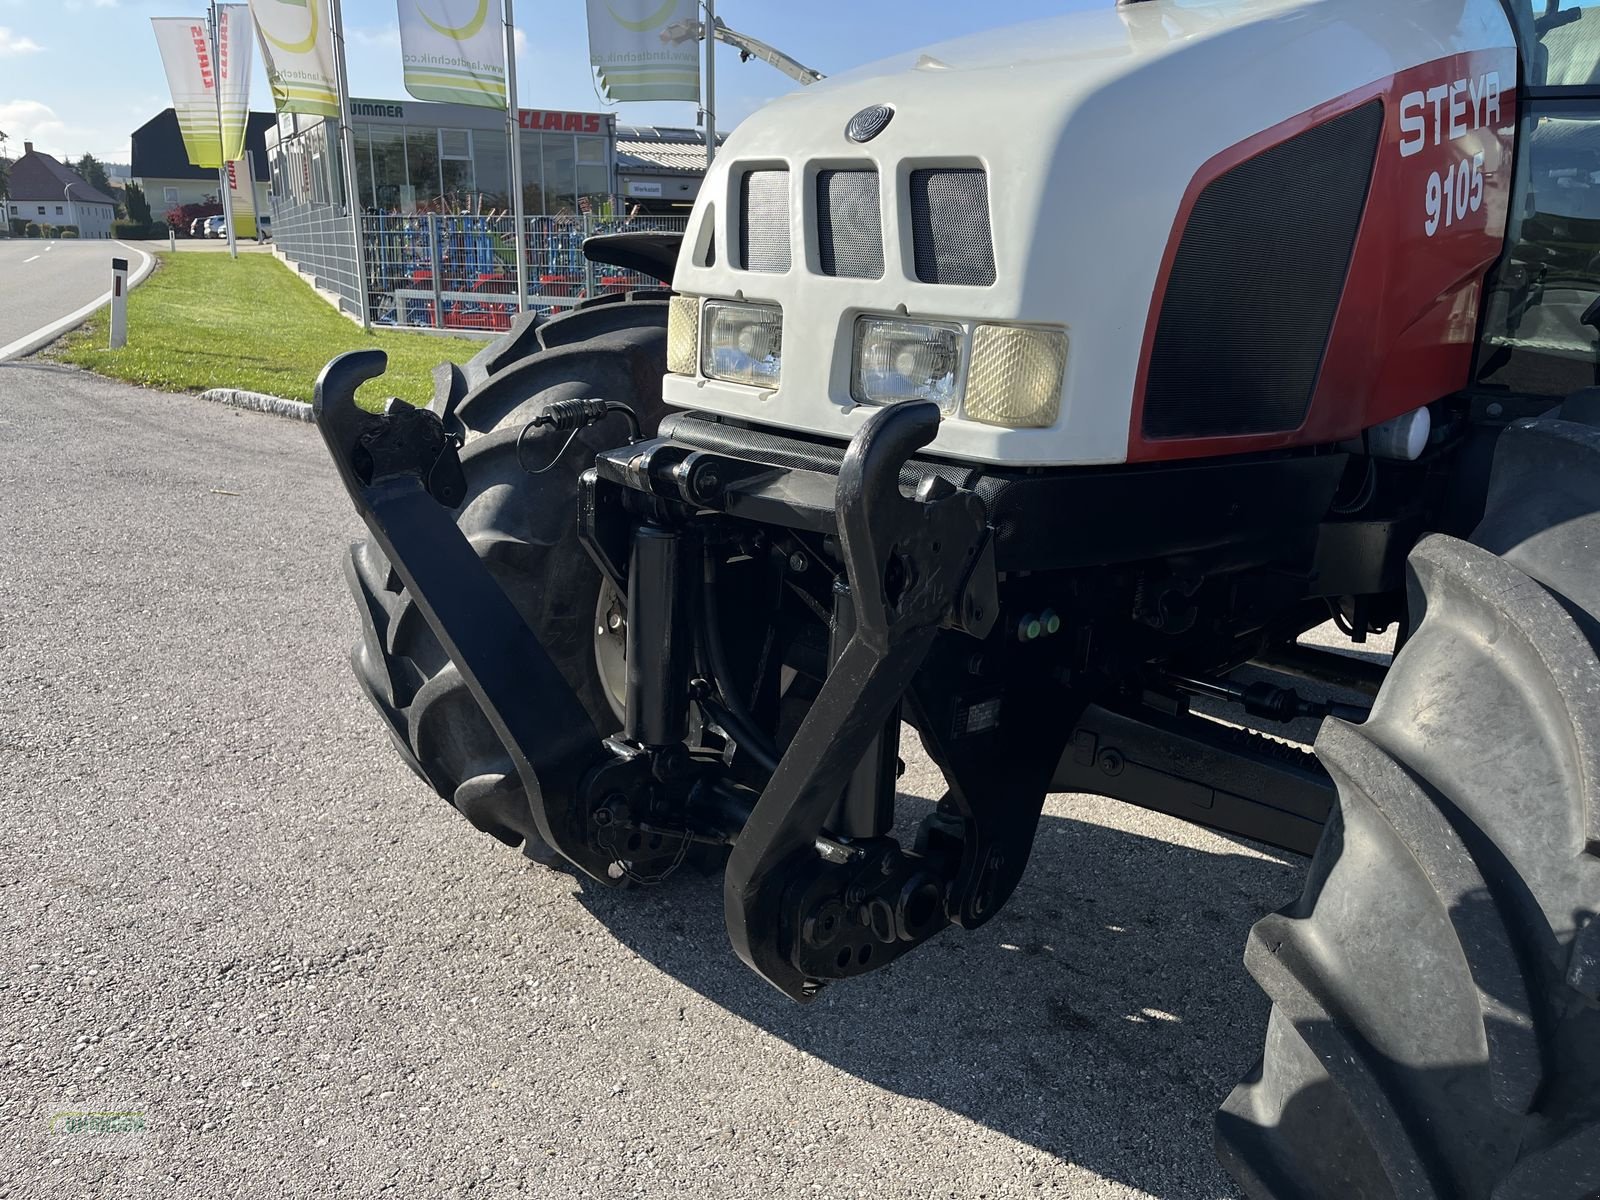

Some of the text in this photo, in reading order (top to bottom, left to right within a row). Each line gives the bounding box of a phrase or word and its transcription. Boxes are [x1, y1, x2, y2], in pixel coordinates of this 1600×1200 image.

[518, 111, 600, 133] CLAAS
[1400, 71, 1500, 158] STEYR
[1424, 151, 1485, 237] 9105
